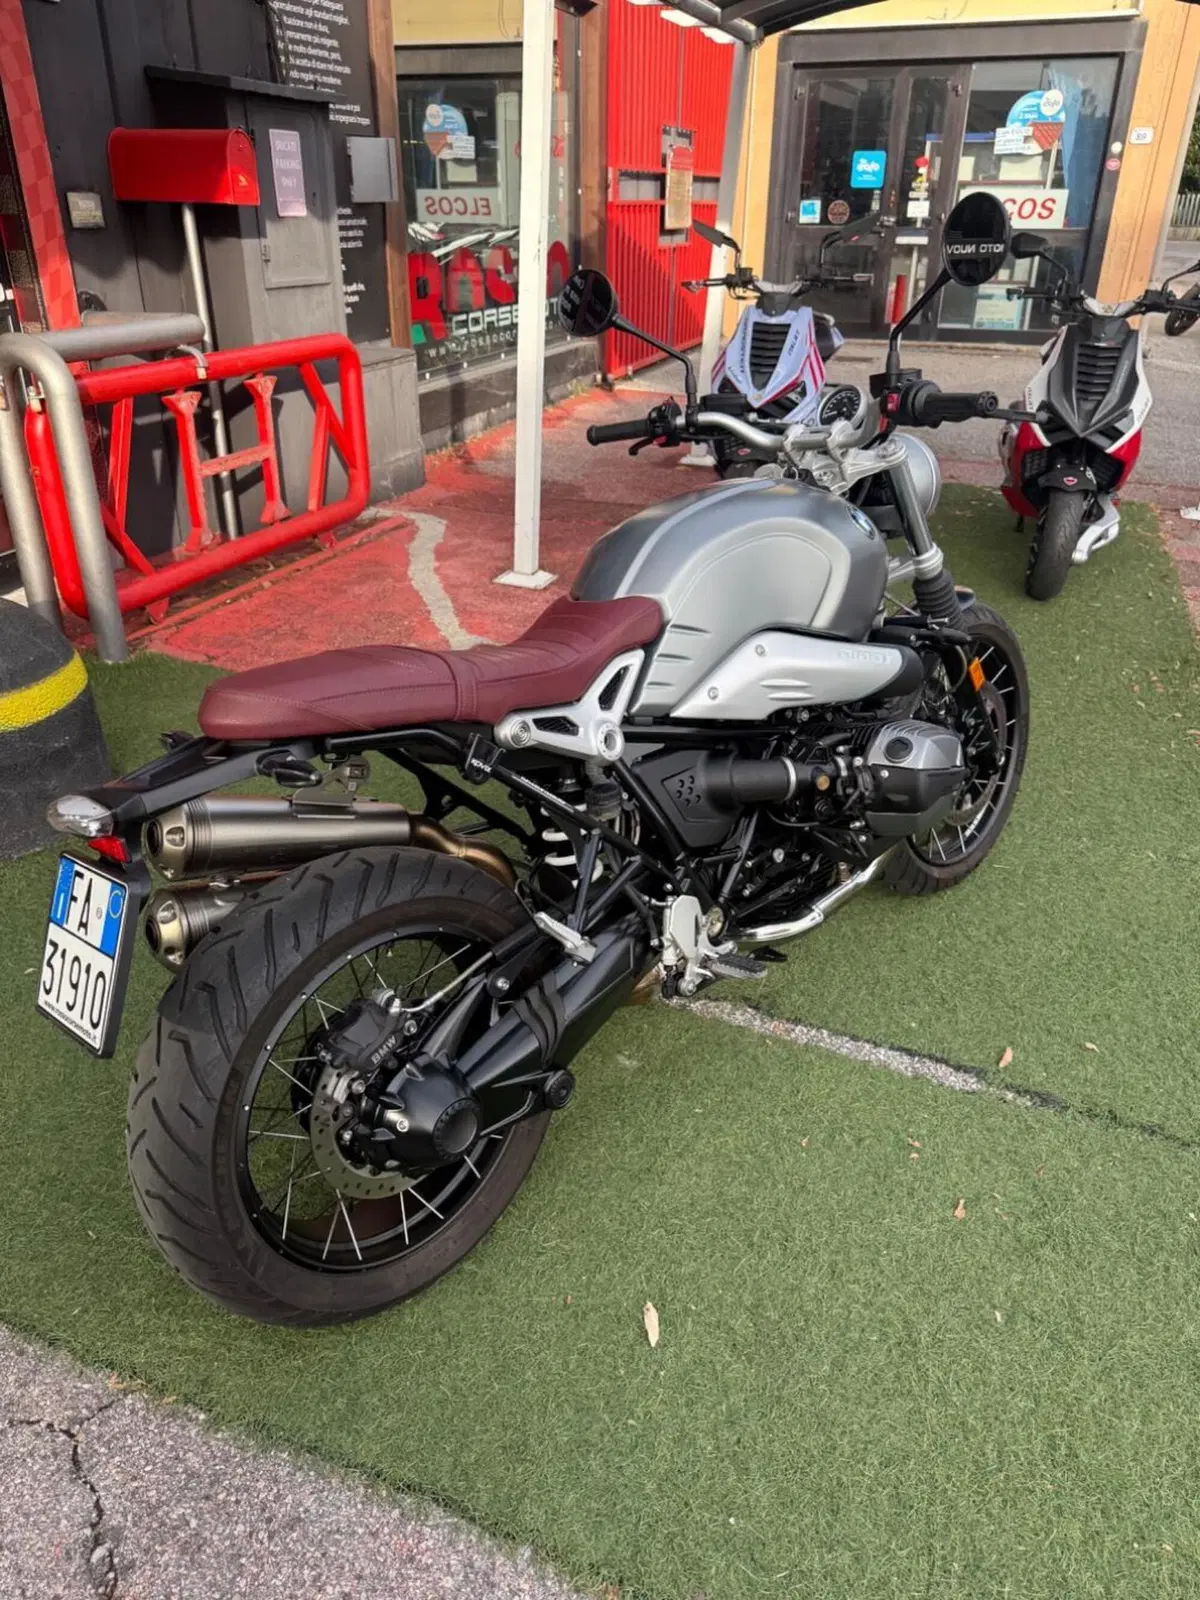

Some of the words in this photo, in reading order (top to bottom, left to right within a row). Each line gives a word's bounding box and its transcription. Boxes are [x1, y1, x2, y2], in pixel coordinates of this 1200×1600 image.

[65, 869, 93, 936] FA
[42, 938, 107, 1030] 31910
[371, 1035, 396, 1065] BMW
